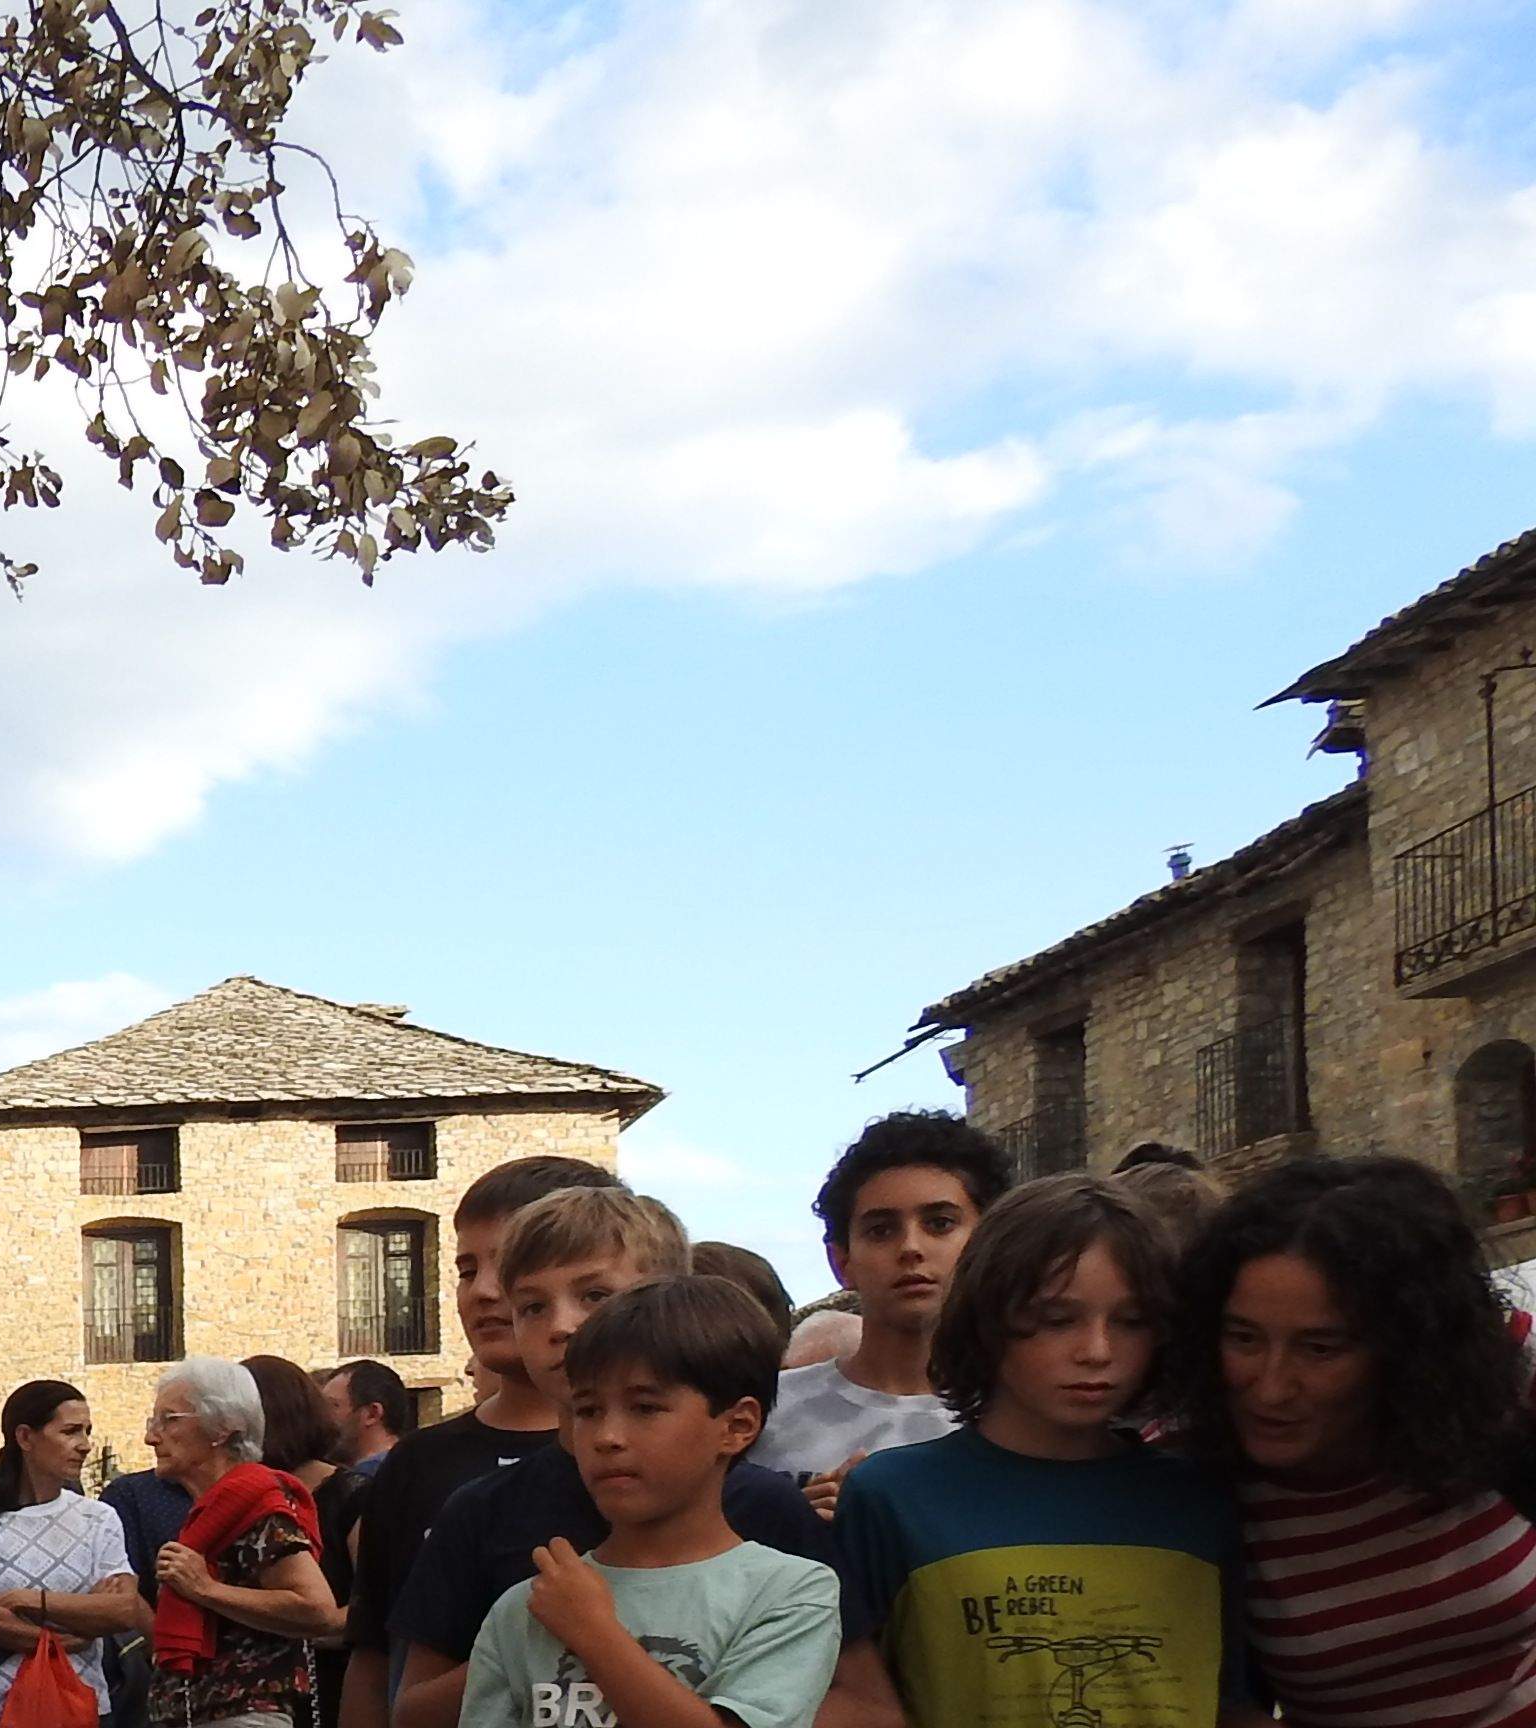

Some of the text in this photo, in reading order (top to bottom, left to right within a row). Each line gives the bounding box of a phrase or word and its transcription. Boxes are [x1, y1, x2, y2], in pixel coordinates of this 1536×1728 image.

[1006, 1575, 1084, 1595] A GREEN
[961, 1595, 1003, 1635] BE
[1006, 1596, 1058, 1616] REBEL
